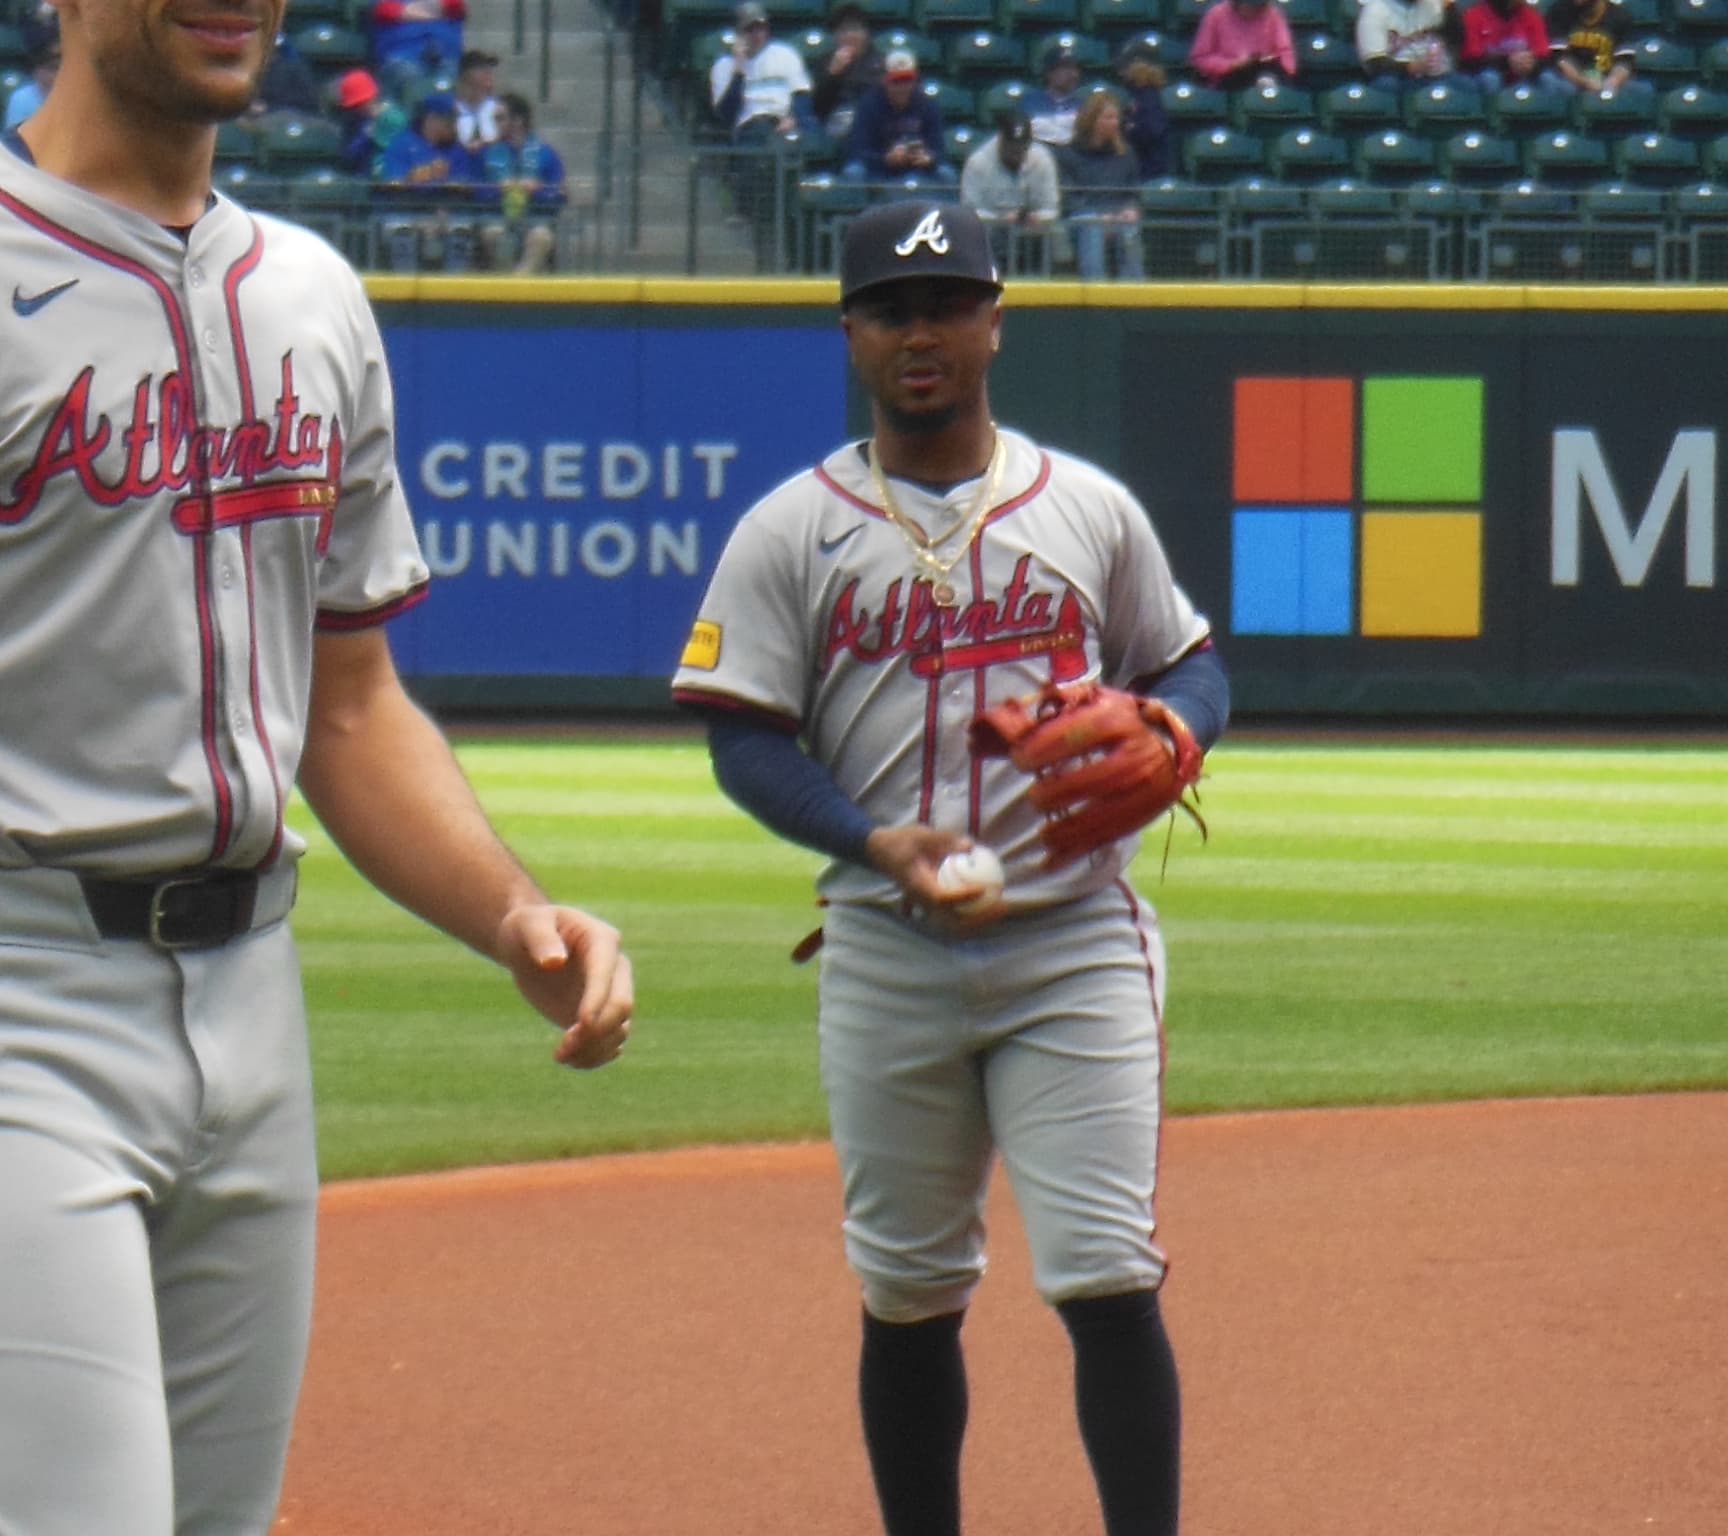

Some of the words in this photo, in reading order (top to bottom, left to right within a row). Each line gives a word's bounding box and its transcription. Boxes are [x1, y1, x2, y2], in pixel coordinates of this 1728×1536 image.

[895, 210, 949, 257] A
[422, 443, 738, 498] CREDIT
[423, 521, 699, 577] UNION
[822, 552, 1054, 676] Atlanta
